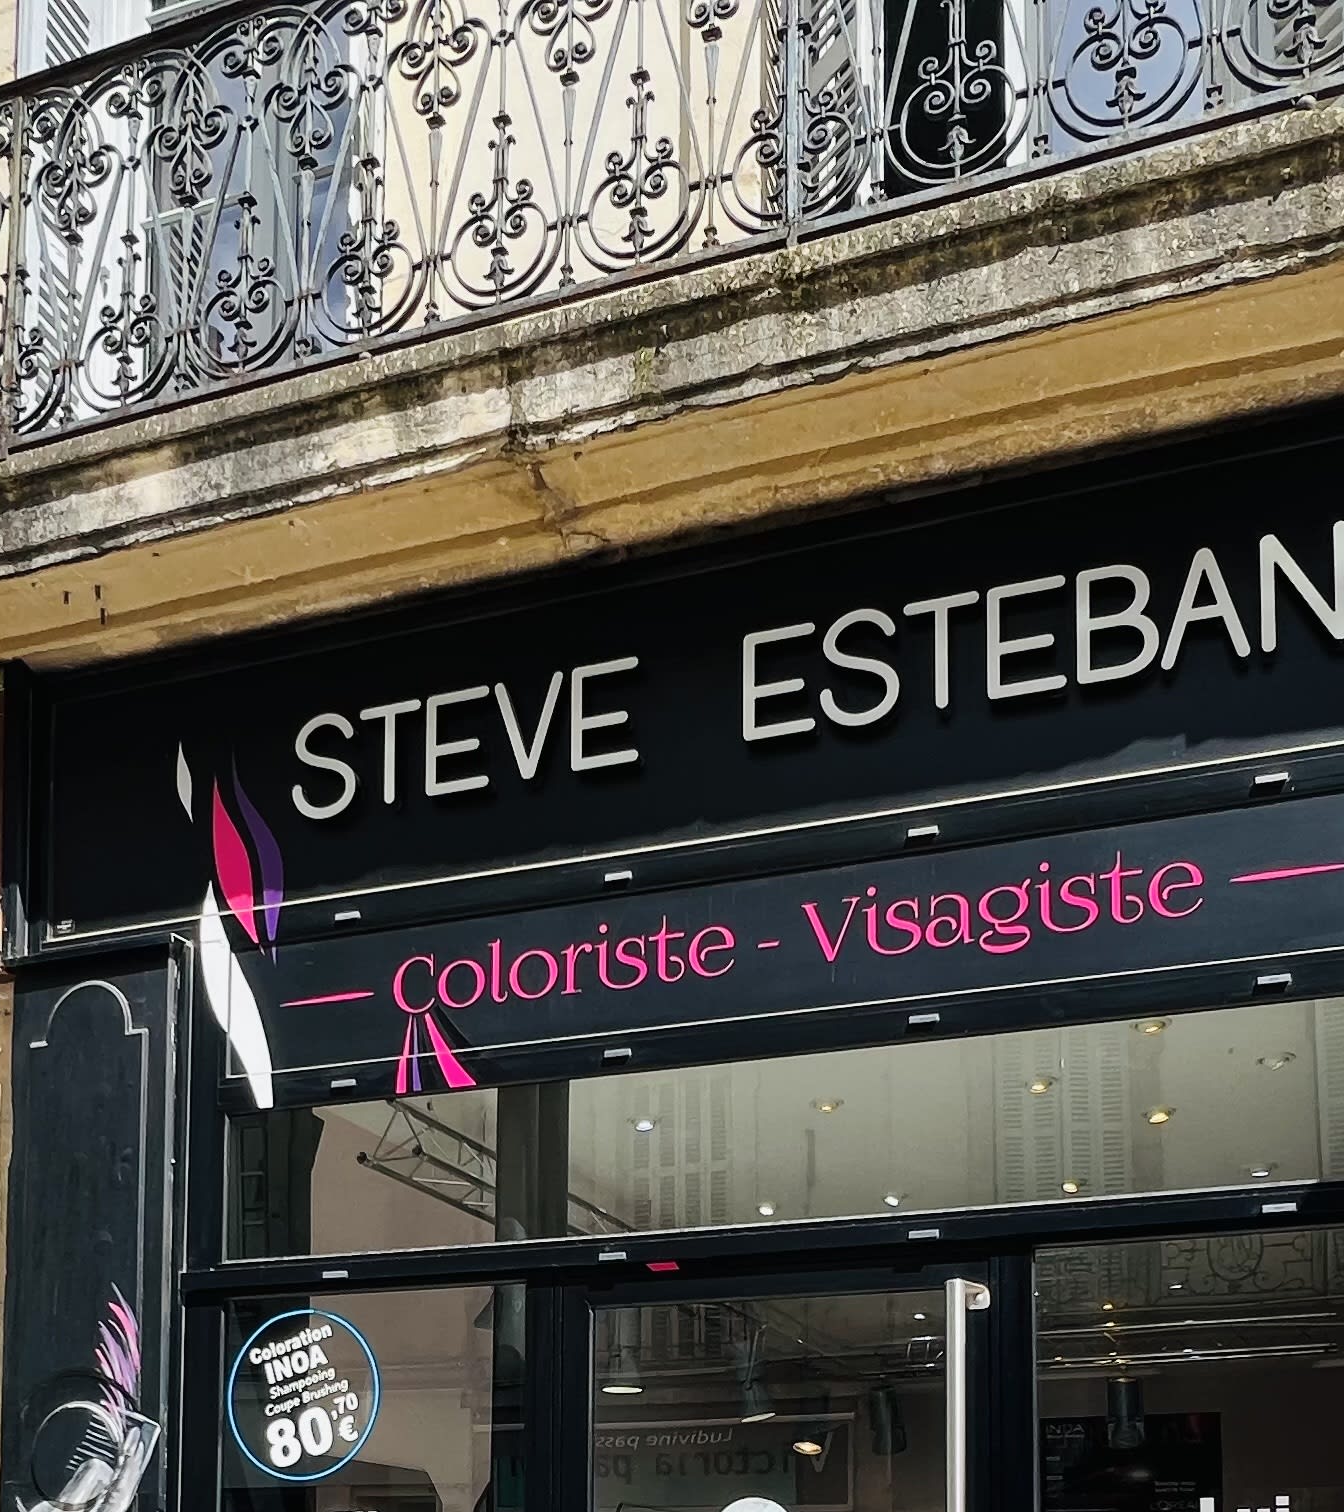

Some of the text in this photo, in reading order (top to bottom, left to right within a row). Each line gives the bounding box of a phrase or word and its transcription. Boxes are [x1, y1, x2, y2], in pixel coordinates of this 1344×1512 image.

[291, 656, 640, 820] STEVE
[392, 913, 736, 1017] Coloriste
[802, 850, 1205, 964] Visagiste
[249, 1324, 334, 1365] Coloration
[264, 1344, 329, 1385] INOA
[264, 1379, 349, 1417] Coupe Brushing
[269, 1367, 336, 1399] Shampooing
